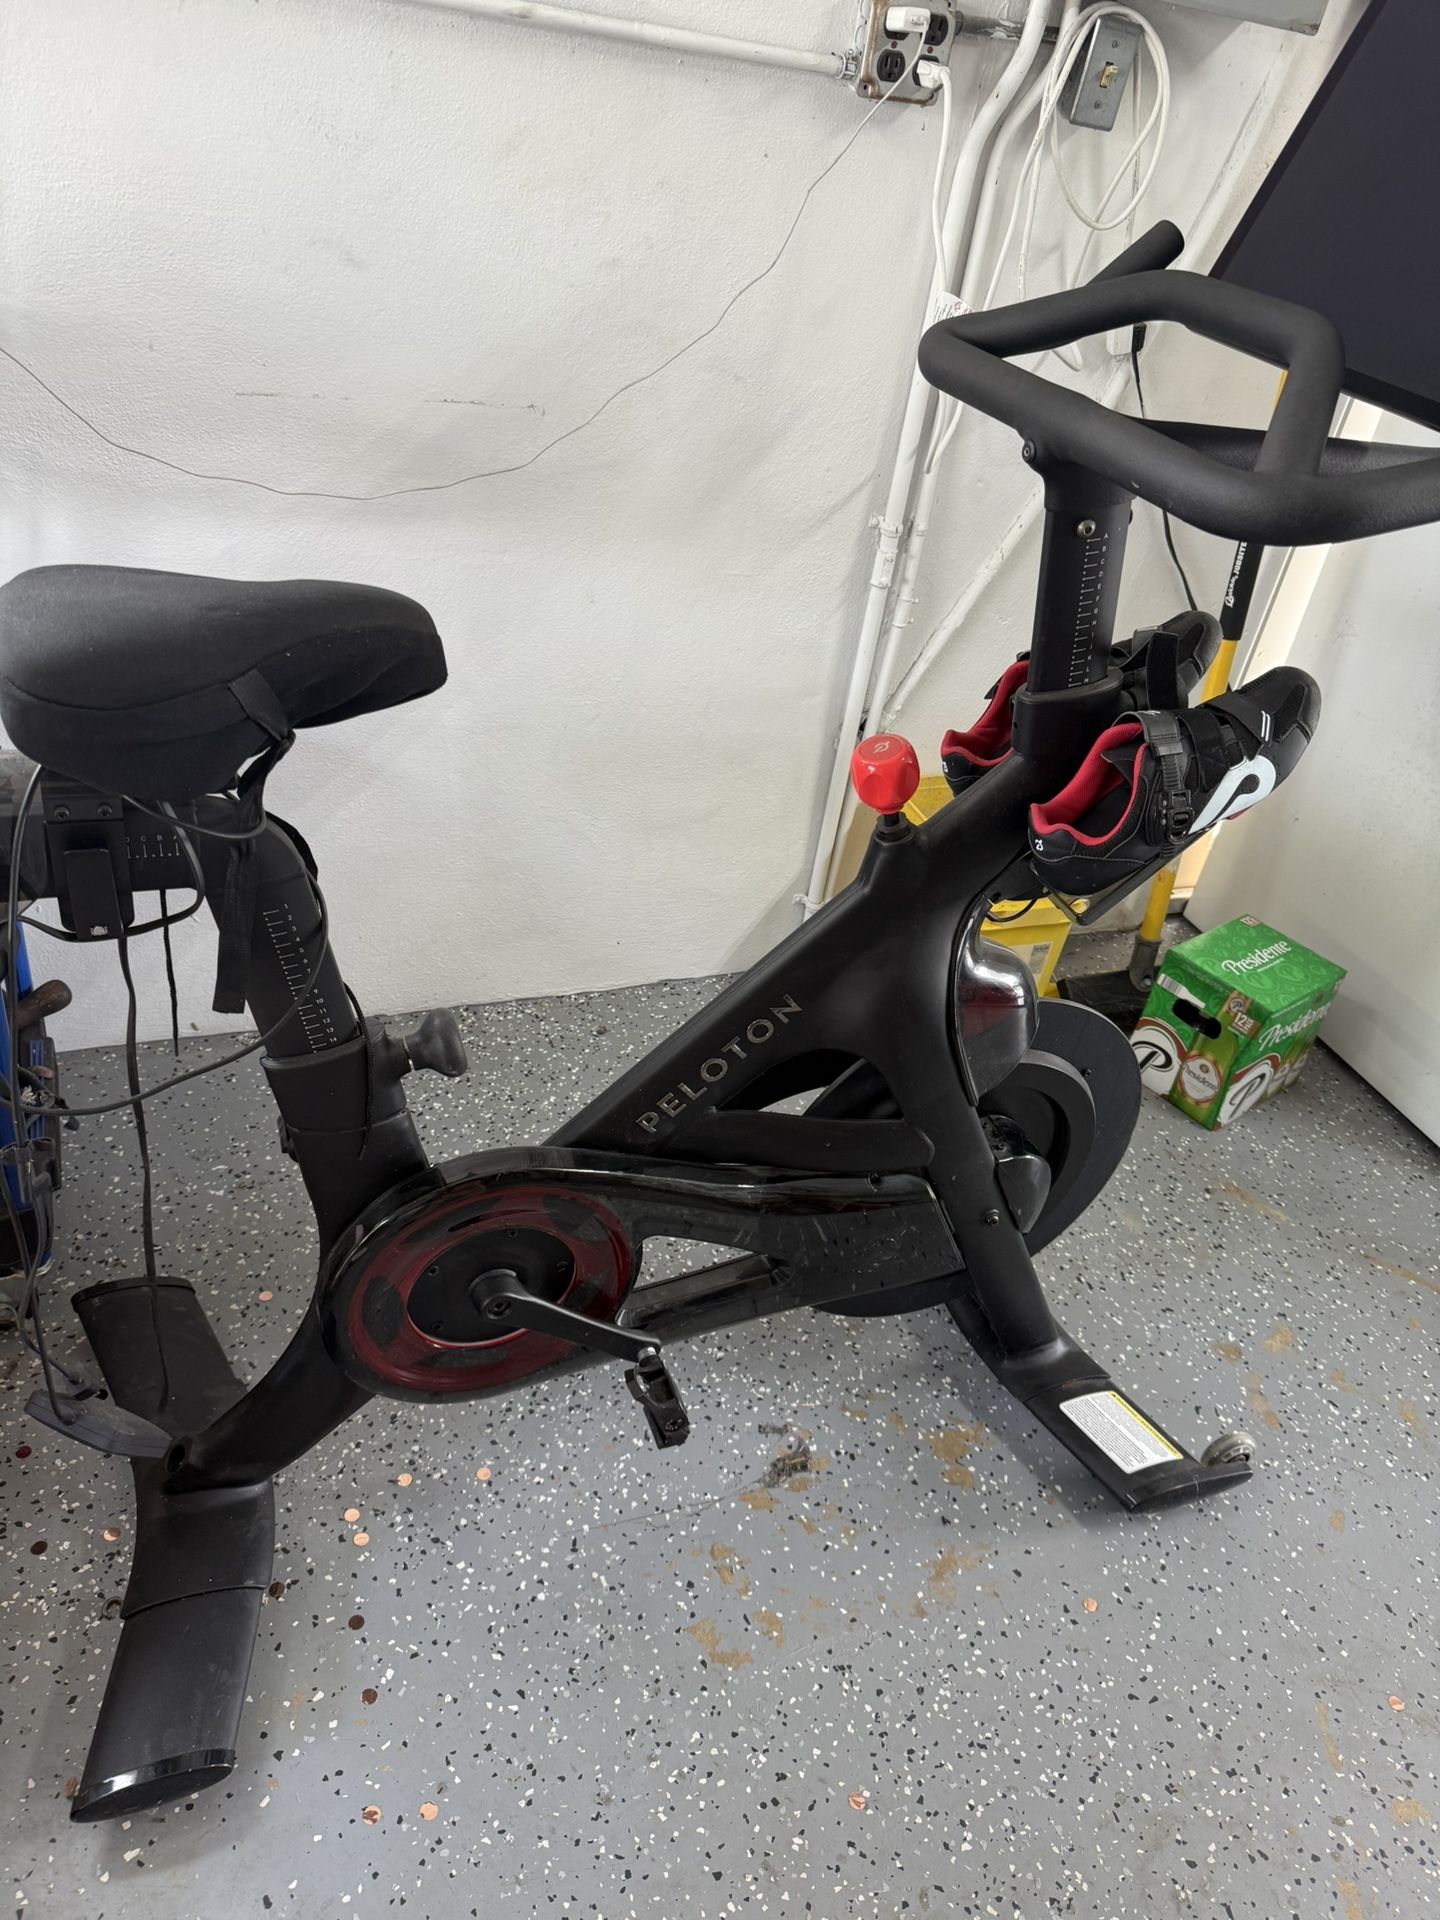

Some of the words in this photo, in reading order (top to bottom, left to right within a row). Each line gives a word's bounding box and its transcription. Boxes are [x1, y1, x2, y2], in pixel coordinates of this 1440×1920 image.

[1233, 541, 1248, 575] JOBSITE
[1221, 941, 1291, 976] Presidente
[1234, 1012, 1248, 1027] 12
[635, 994, 804, 1134] PELOTON
